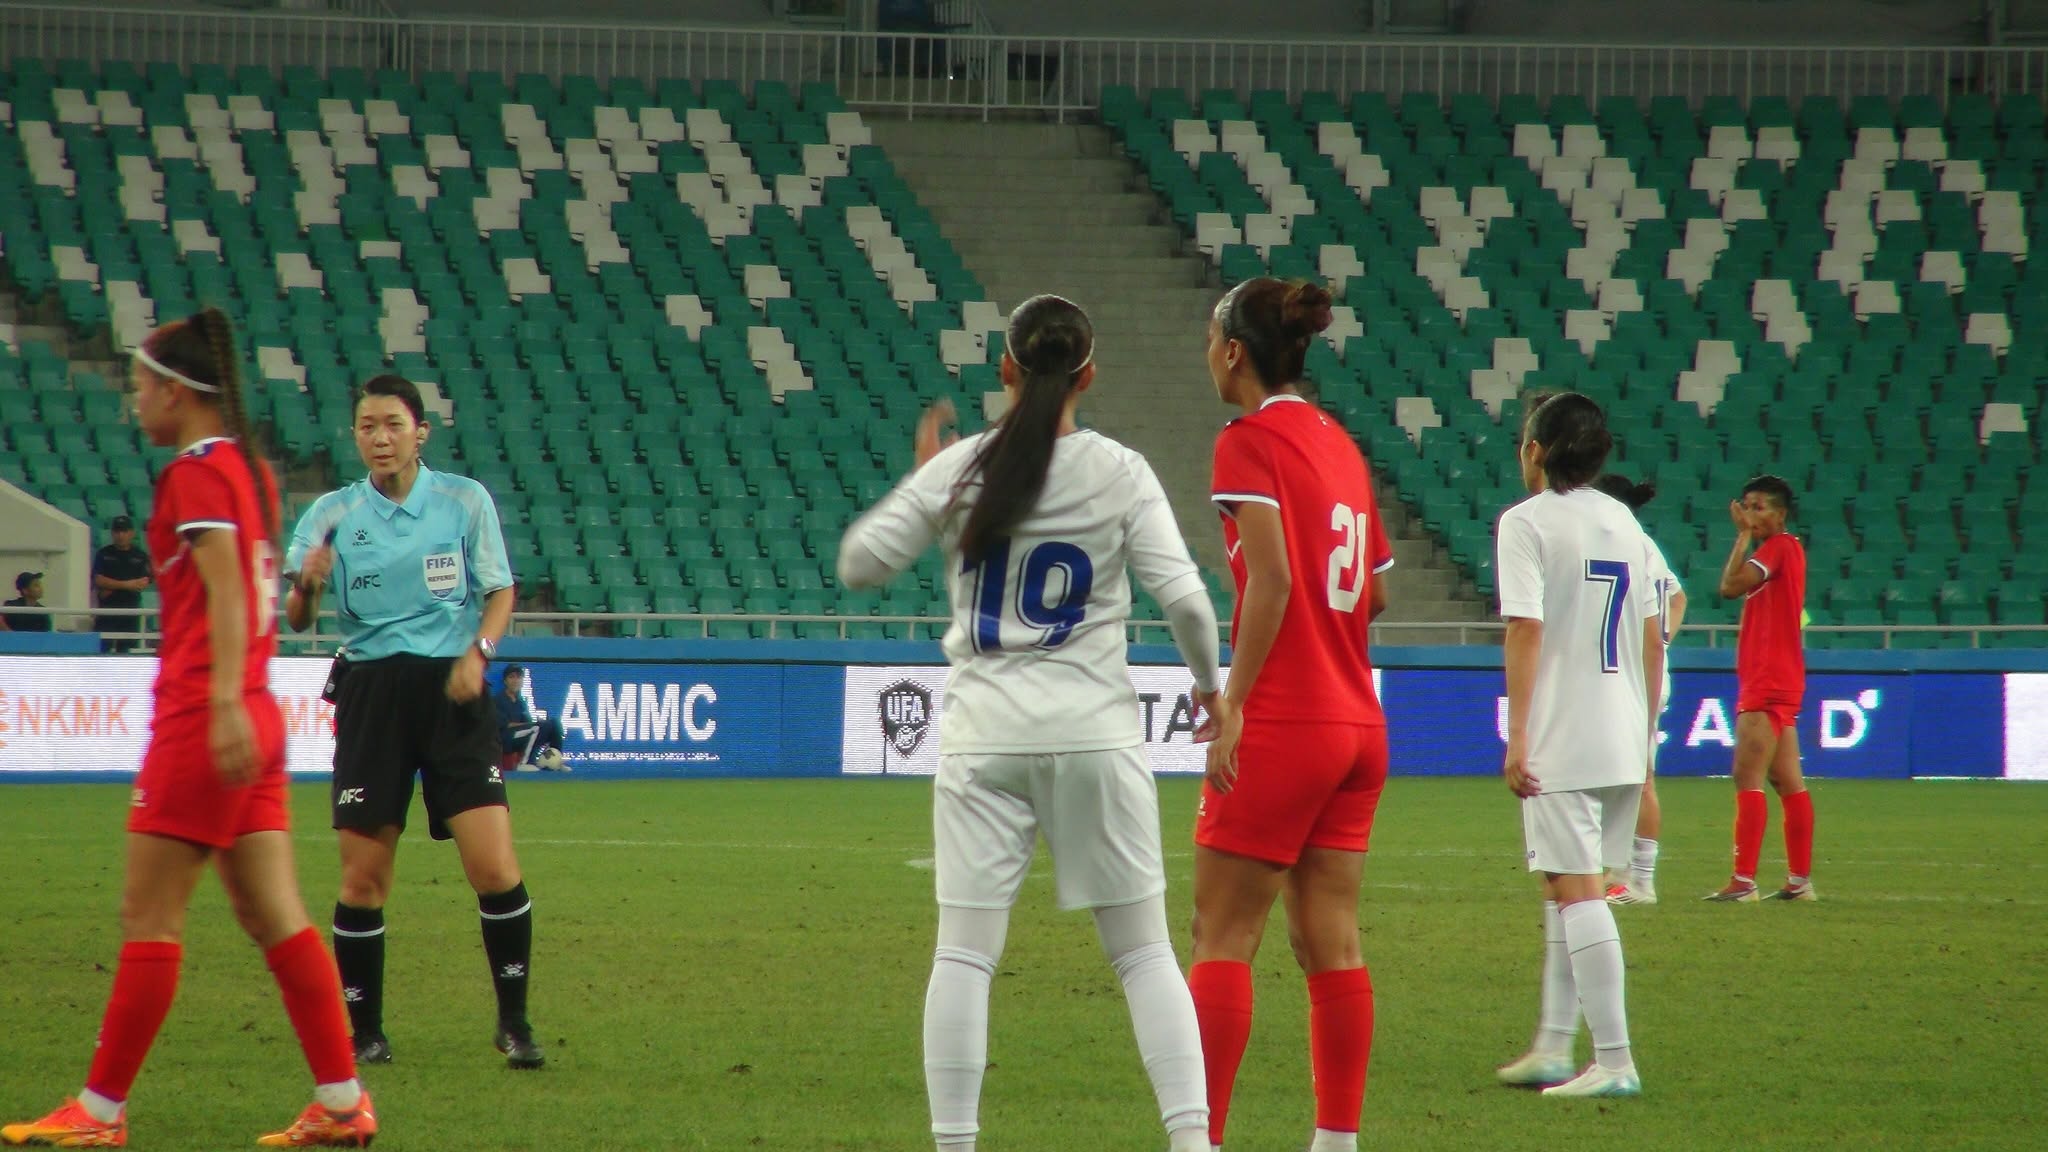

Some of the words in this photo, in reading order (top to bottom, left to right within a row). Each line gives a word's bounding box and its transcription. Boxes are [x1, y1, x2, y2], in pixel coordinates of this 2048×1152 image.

[426, 556, 456, 570] FIFA
[1327, 502, 1367, 613] 21
[351, 574, 382, 590] AFC
[958, 535, 1093, 655] 19
[1584, 558, 1631, 674] 7
[17, 696, 129, 735] NKMK
[561, 683, 717, 740] AMMC
[887, 695, 925, 723] UFA
[338, 787, 365, 805] AFC
